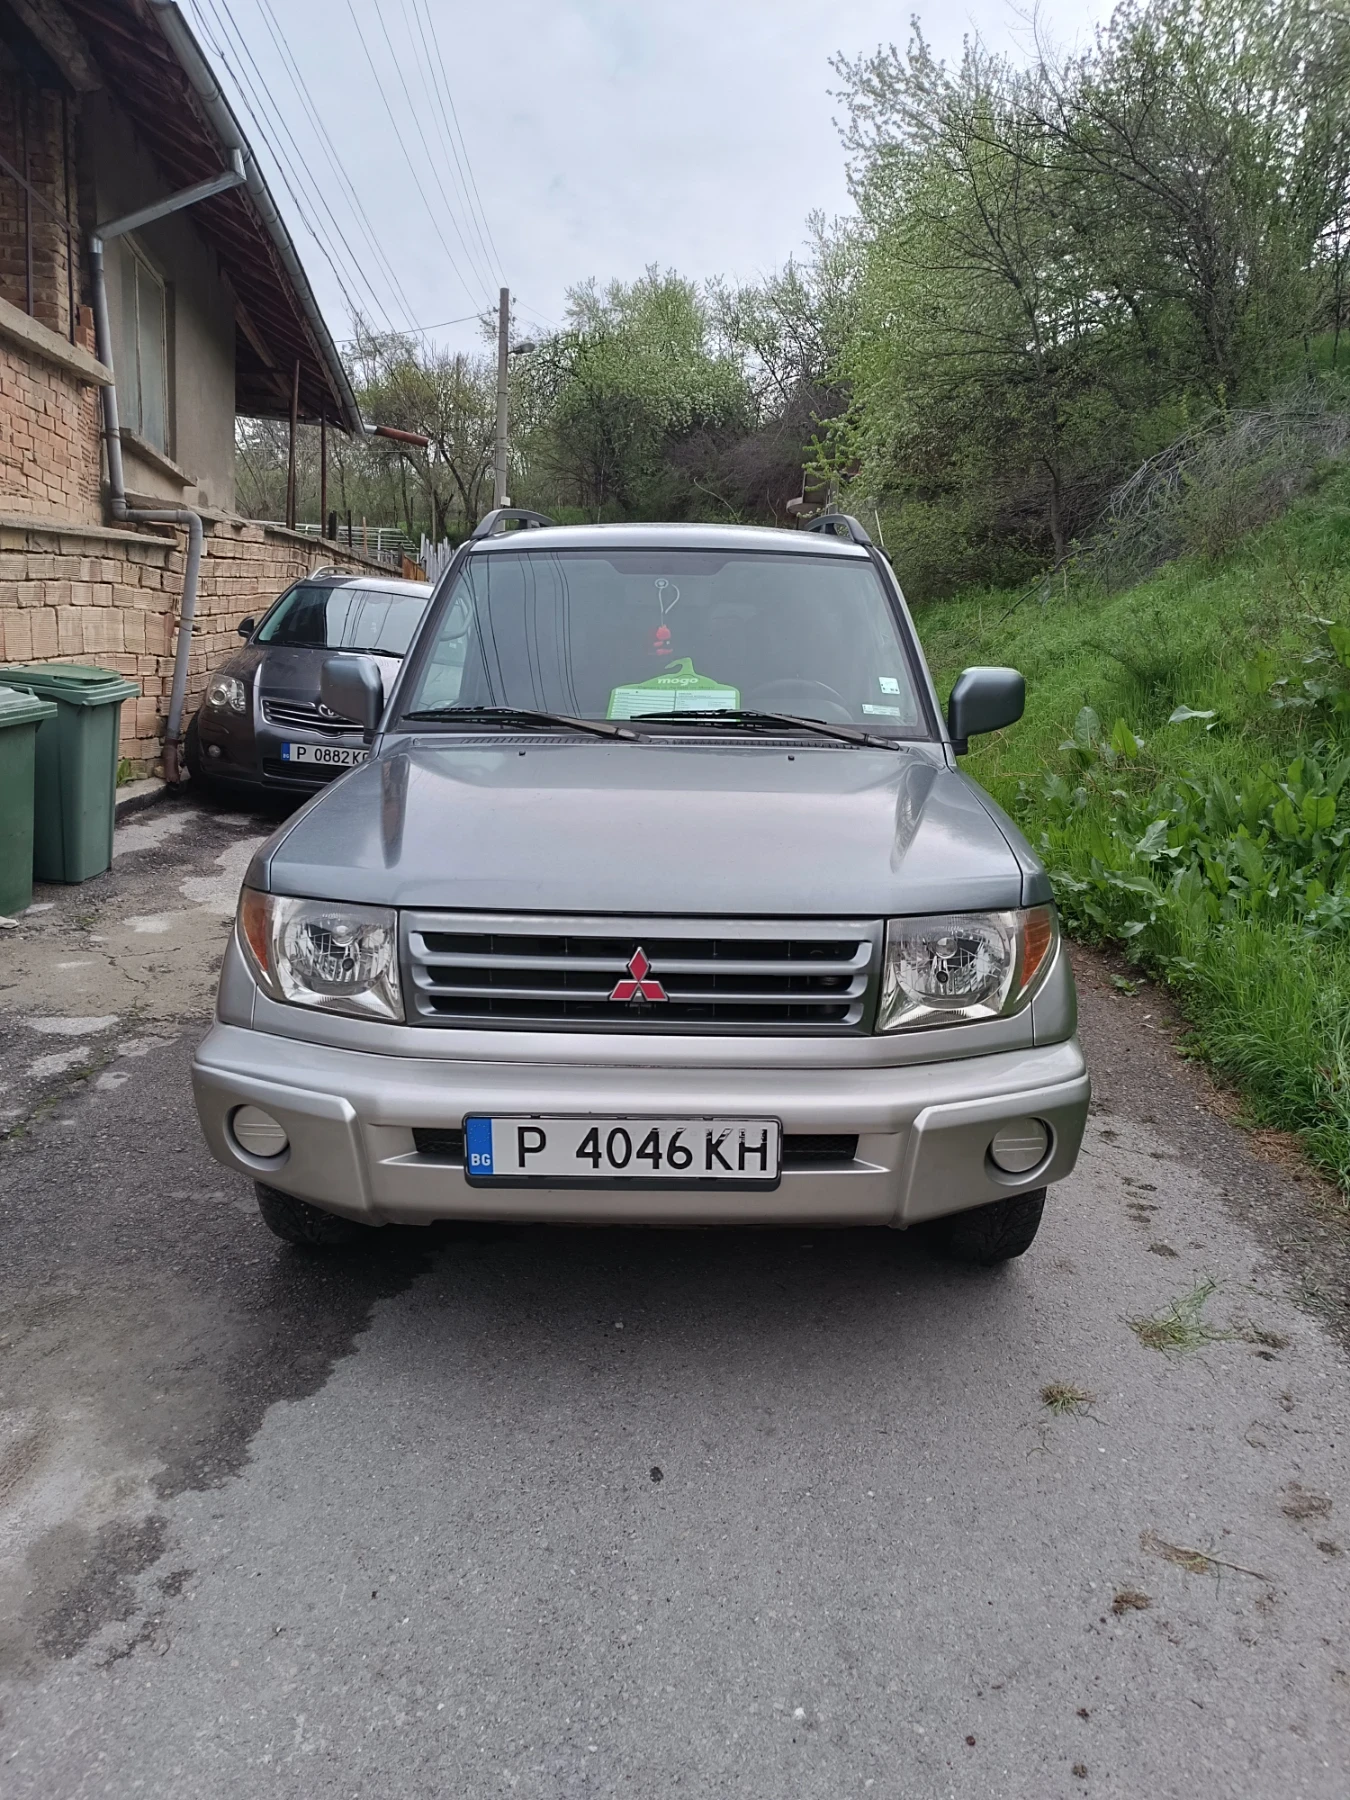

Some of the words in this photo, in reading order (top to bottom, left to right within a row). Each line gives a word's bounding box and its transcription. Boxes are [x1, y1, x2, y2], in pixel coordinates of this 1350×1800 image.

[657, 677, 699, 686] mogo
[296, 746, 307, 760] P
[314, 748, 350, 764] 0882
[517, 1126, 547, 1168] P
[575, 1127, 693, 1170] 4046
[705, 1128, 768, 1171] KH
[471, 1153, 491, 1166] BG
